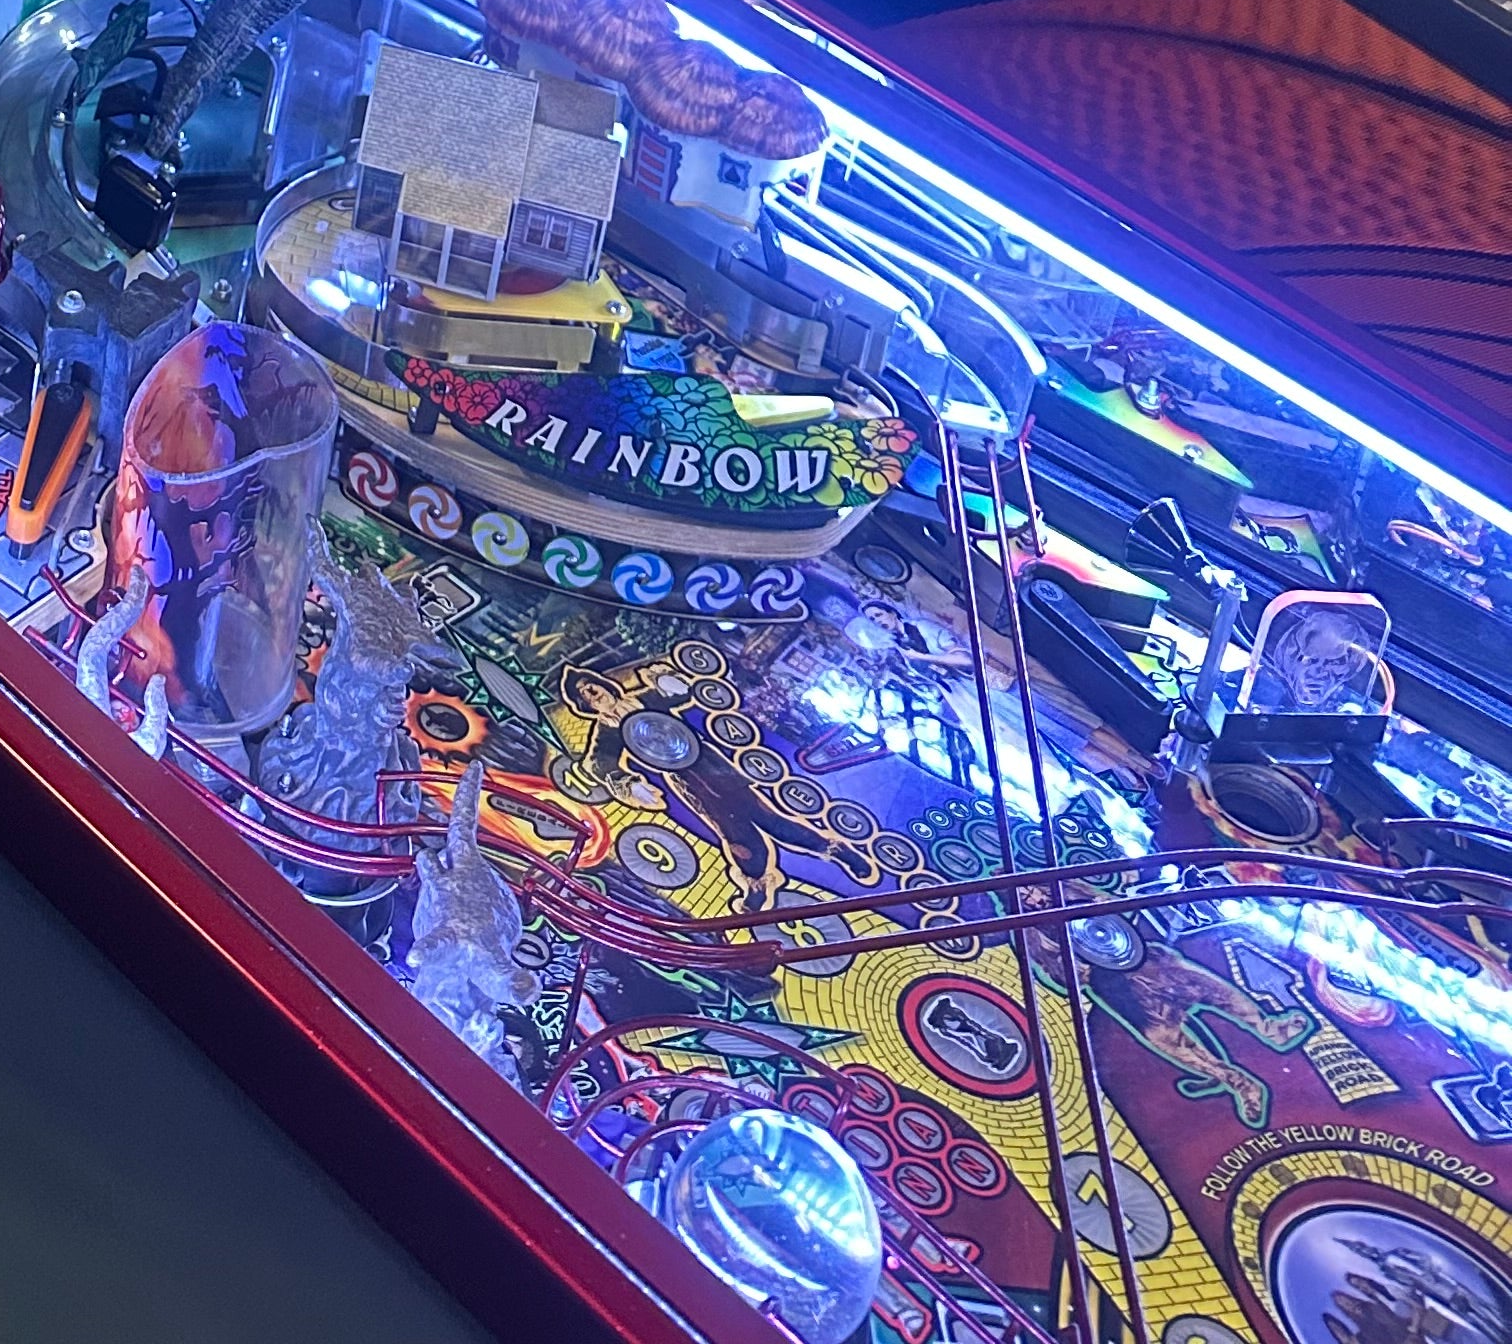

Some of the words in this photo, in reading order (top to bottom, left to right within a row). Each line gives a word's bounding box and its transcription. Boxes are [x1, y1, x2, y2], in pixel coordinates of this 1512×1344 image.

[486, 398, 829, 494] RAINBOW
[637, 837, 677, 873] 9
[1314, 1051, 1368, 1068] YELLOW
[1326, 1062, 1377, 1080] BRICK
[1334, 1074, 1385, 1093] ROAD
[1201, 1145, 1251, 1201] FOLLOW
[1245, 1131, 1283, 1156] THE
[1279, 1124, 1356, 1145] YELLOW
[1359, 1127, 1425, 1159] BRICK
[1424, 1149, 1496, 1188] ROAD
